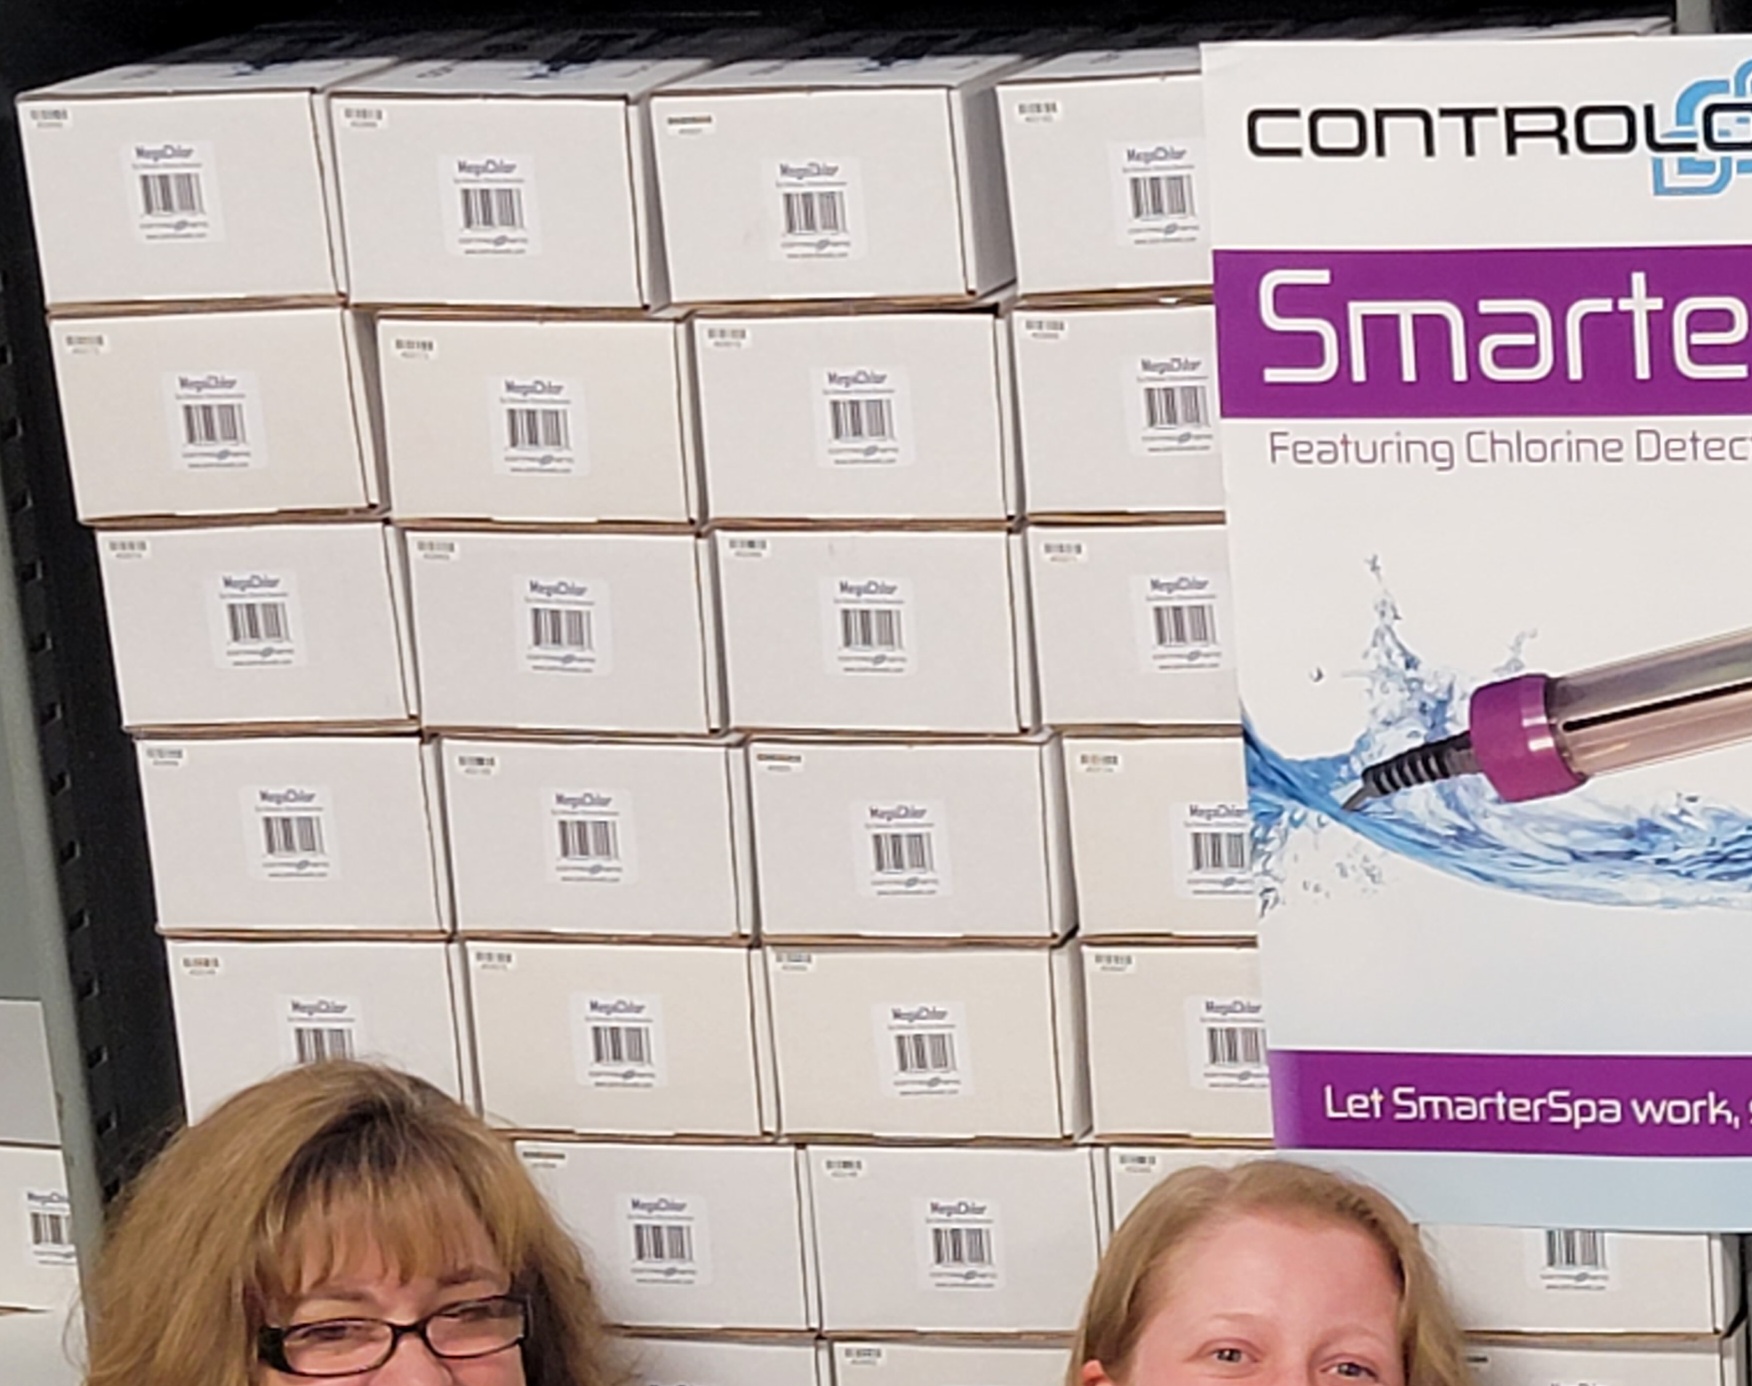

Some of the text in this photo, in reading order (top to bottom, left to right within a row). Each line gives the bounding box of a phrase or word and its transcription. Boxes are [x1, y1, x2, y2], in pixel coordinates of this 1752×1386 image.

[1269, 431, 1455, 471] Featuring
[1466, 430, 1624, 463] Chlorine
[1324, 1084, 1384, 1120] Let
[1392, 1086, 1622, 1129] SmarterSpa
[1631, 1091, 1740, 1129] work,
